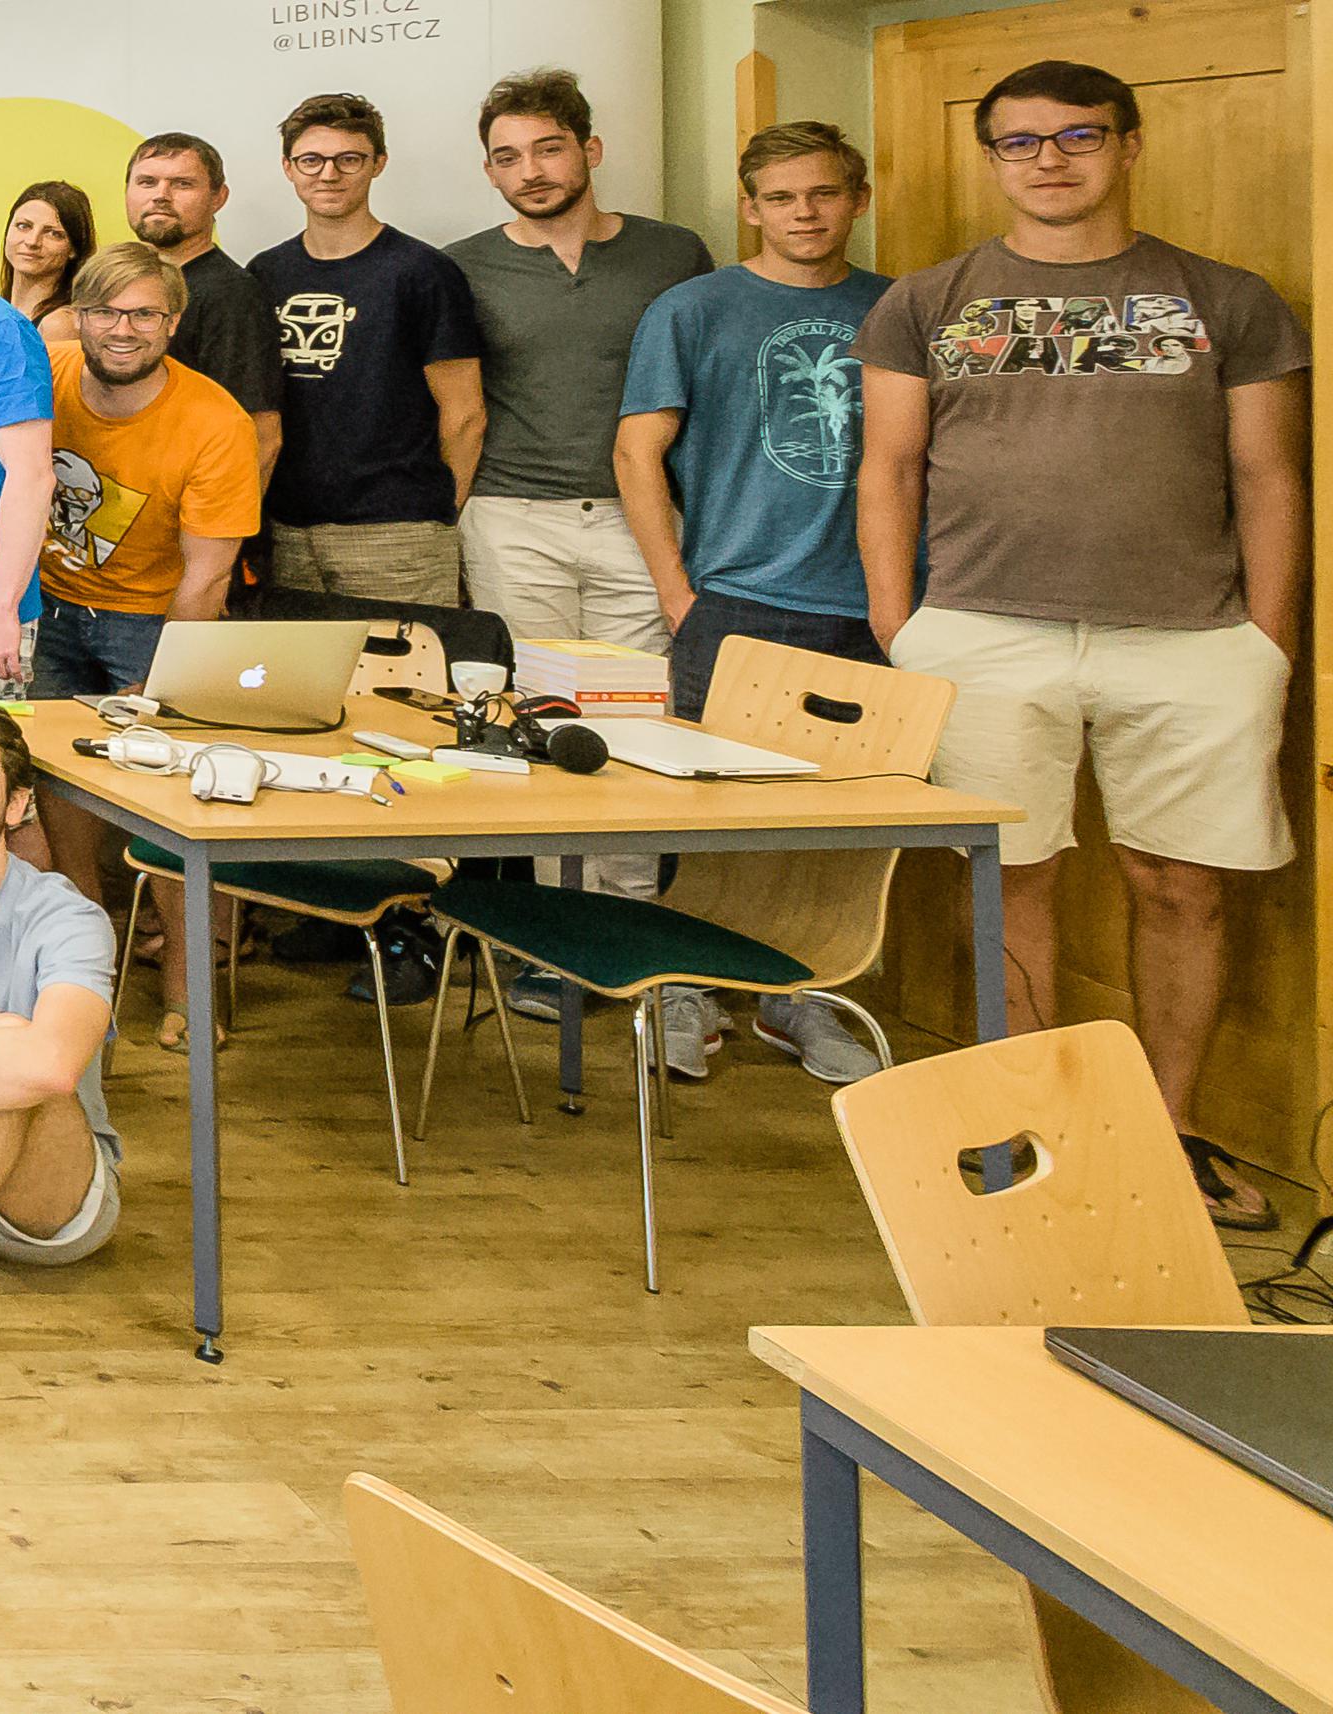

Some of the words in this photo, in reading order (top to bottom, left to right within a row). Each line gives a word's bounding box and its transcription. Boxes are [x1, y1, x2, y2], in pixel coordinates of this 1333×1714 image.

[273, 19, 441, 52] @LIBINSTCZ
[829, 327, 855, 344] FLO
[930, 293, 1206, 340] STAR
[929, 334, 1211, 381] WARS
